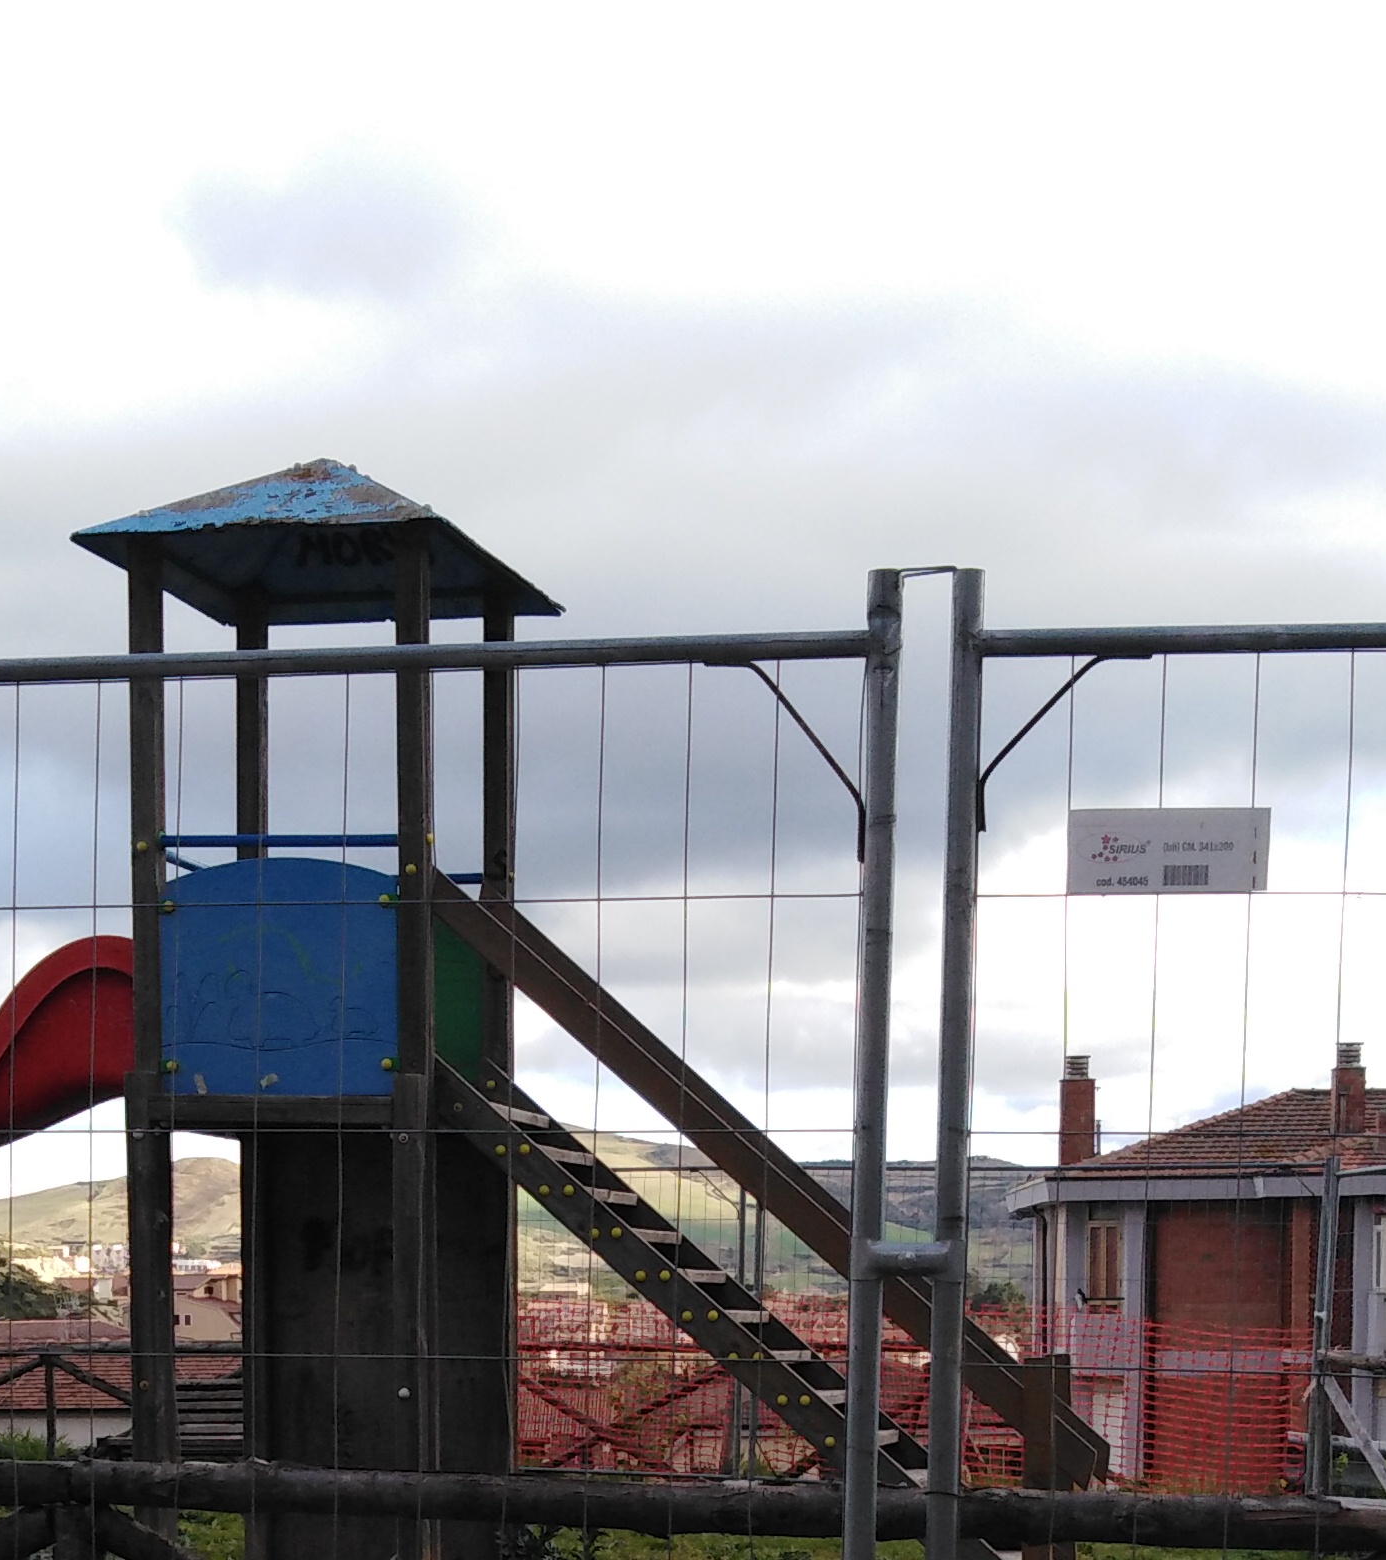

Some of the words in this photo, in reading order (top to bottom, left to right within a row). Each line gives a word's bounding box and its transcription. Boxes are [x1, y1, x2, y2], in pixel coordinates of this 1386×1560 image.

[1107, 843, 1147, 855] SIRIUS
[1095, 877, 1114, 887] cod.
[1116, 876, 1149, 887] 454045
